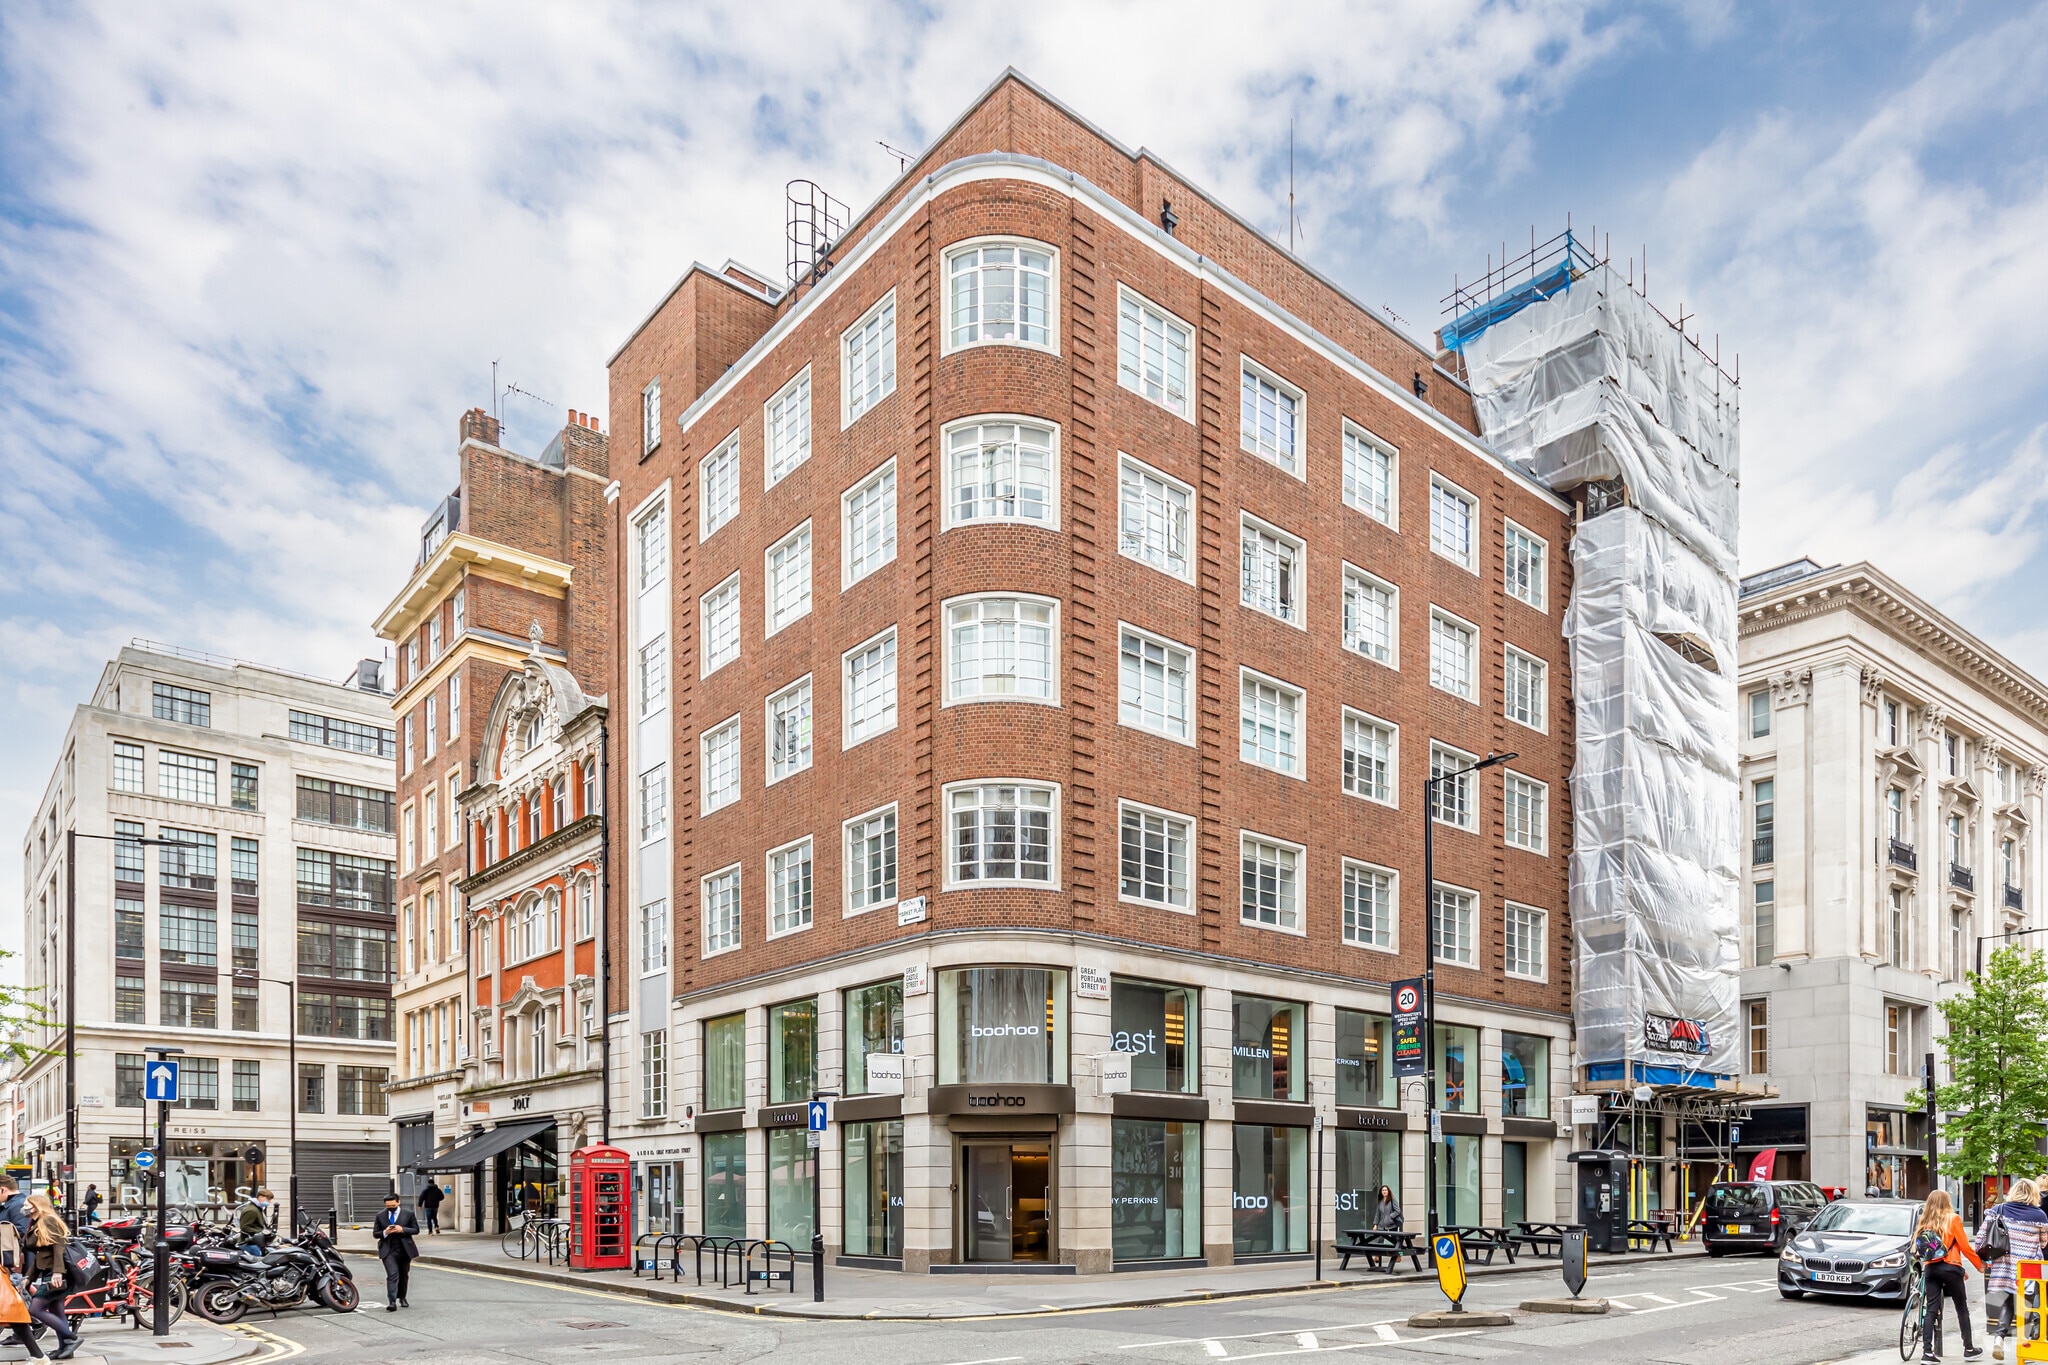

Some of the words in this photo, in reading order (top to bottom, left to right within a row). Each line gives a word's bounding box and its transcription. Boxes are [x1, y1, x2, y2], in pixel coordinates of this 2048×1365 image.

[906, 966, 917, 974] GREAT
[1081, 967, 1096, 975] GREAT
[906, 973, 918, 982] CASTLE
[1081, 975, 1107, 984] PORTLAND
[906, 980, 919, 989] STREET
[1081, 982, 1099, 991] STREET
[1401, 992, 1415, 1005] 20
[972, 1024, 1038, 1036] boohoo
[891, 1035, 904, 1054] b
[1233, 1046, 1270, 1059] MILLEN
[1335, 1058, 1360, 1067] ERKINS
[871, 1070, 902, 1080] boohoo
[1104, 1070, 1127, 1079] boohoo
[512, 1097, 531, 1111] JOLT
[968, 1092, 1026, 1107] boohoo
[121, 1186, 252, 1204] RSS
[1233, 1191, 1268, 1209] hoo
[891, 1196, 904, 1207] KA
[1836, 1275, 1851, 1283] KEK
